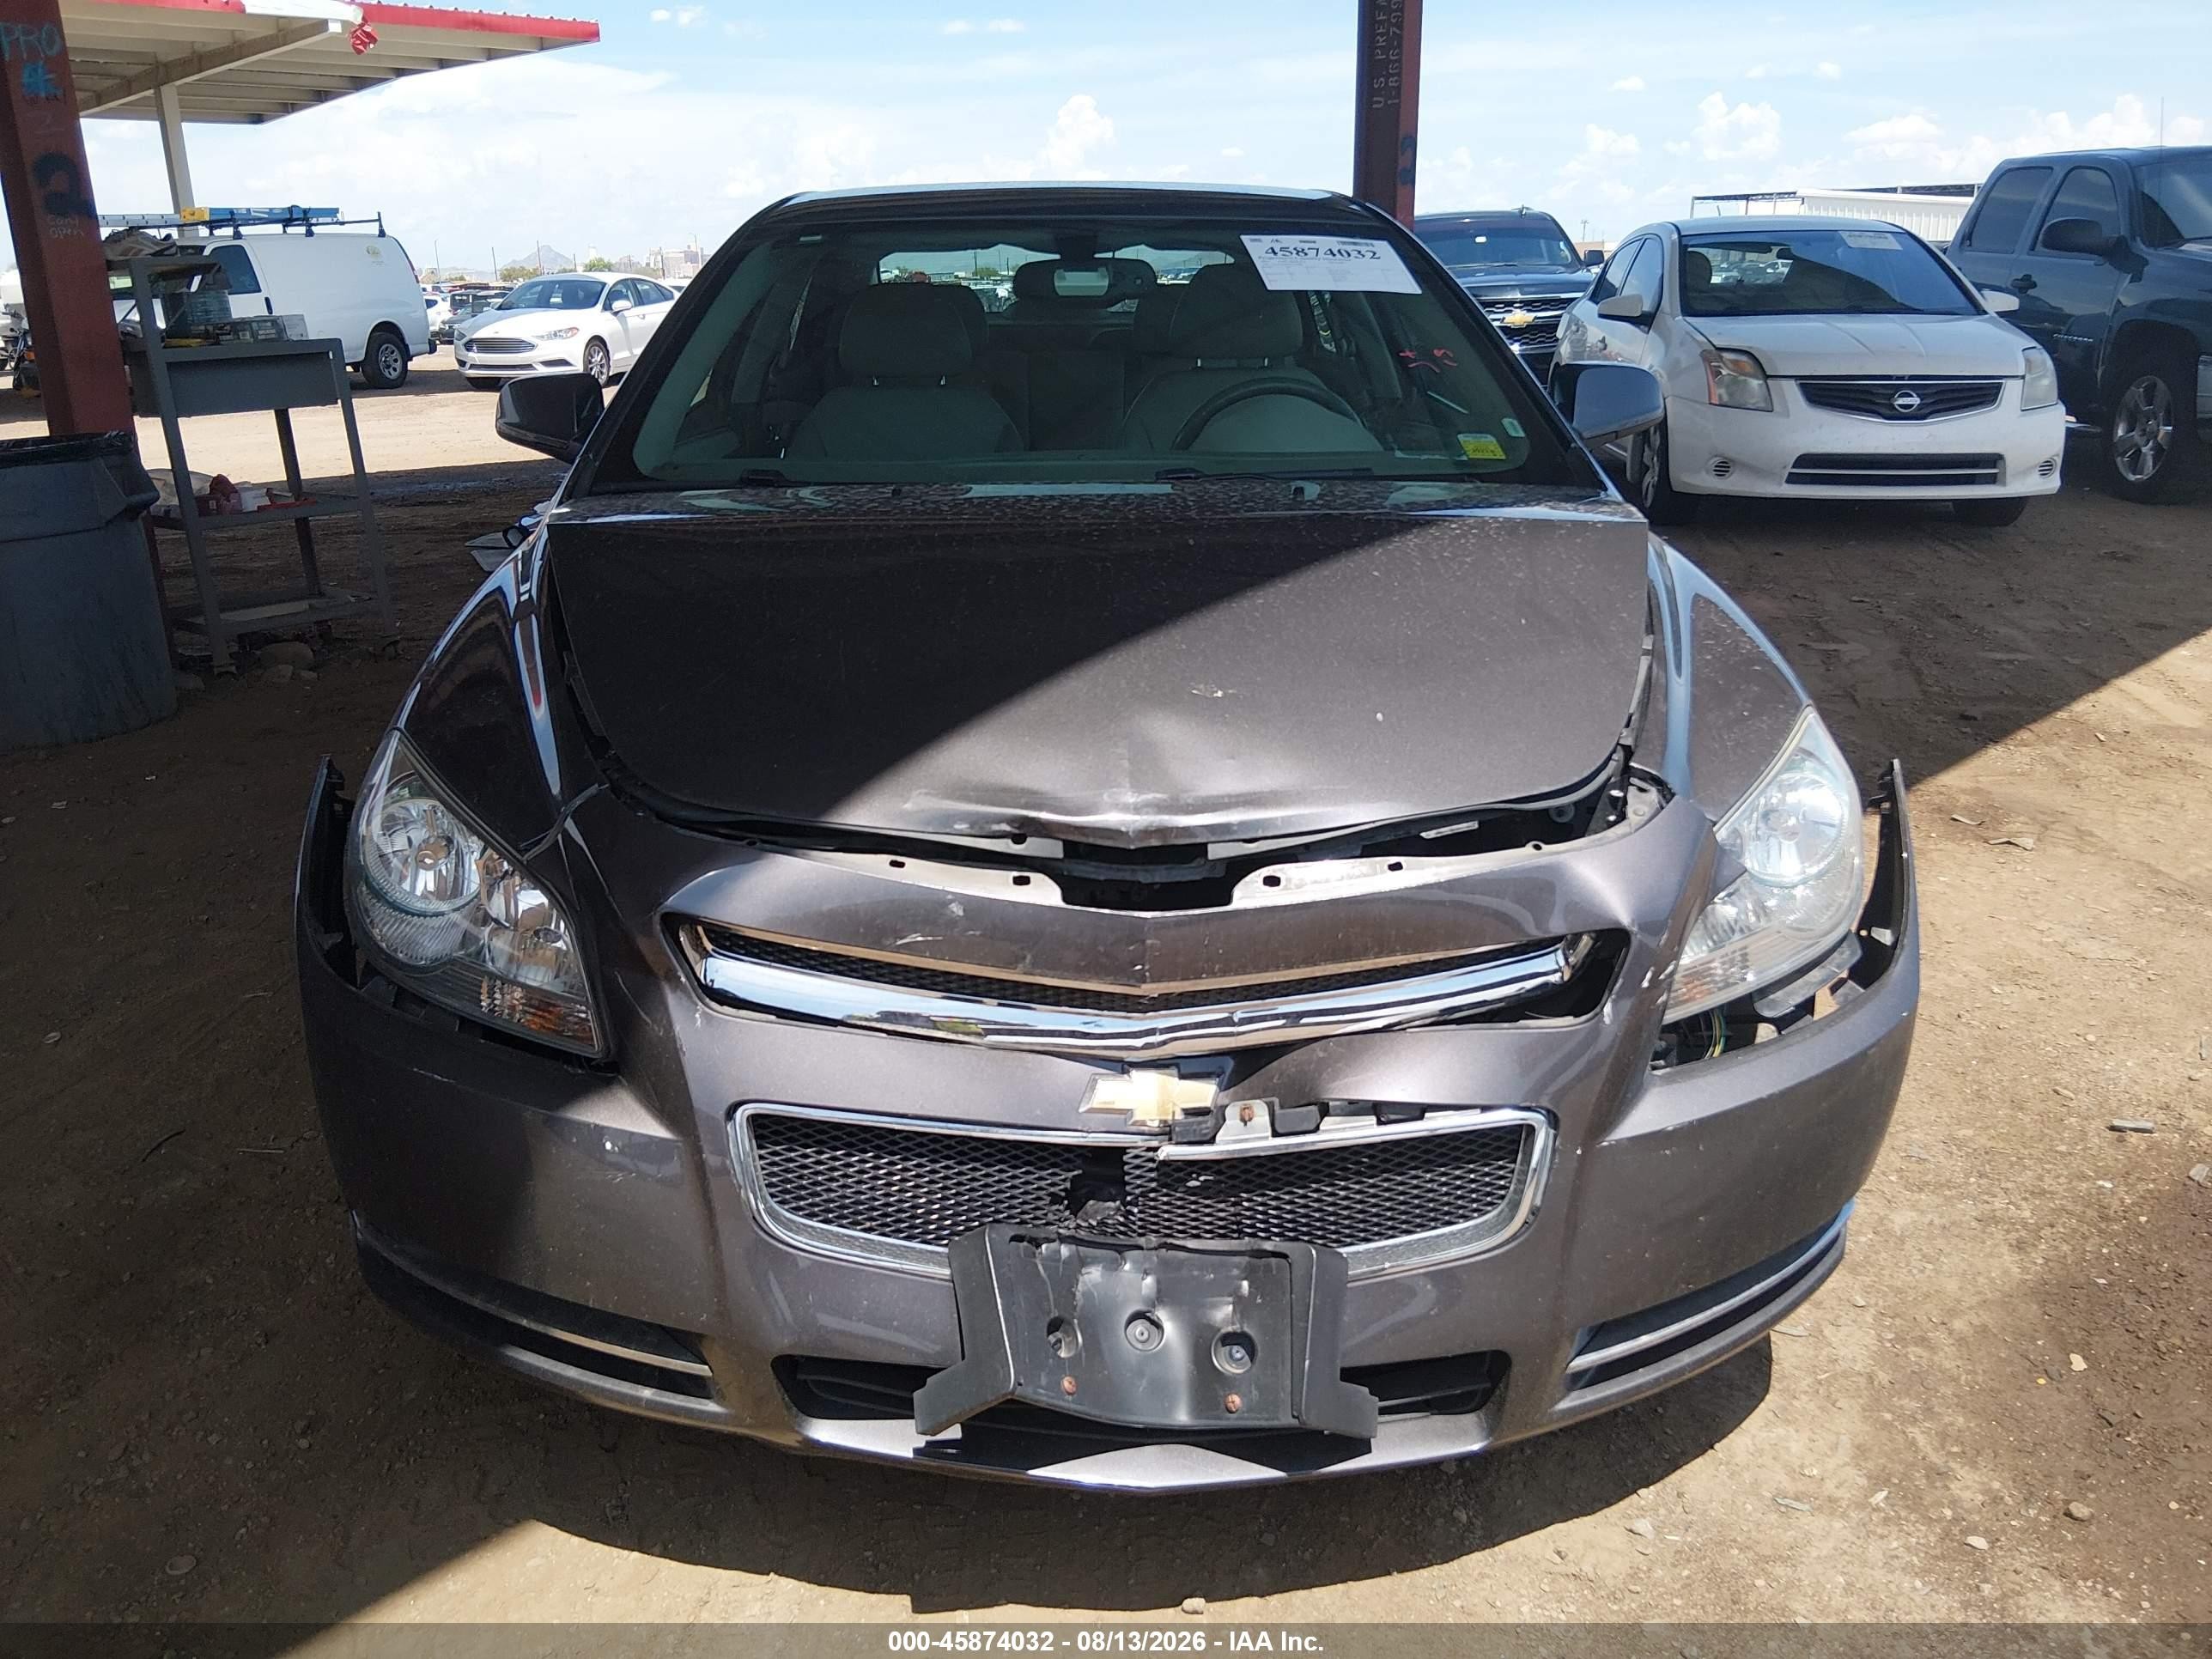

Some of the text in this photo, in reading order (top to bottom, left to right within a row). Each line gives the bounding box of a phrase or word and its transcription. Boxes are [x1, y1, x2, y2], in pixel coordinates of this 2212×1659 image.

[0, 21, 62, 62] PRO
[1372, 71, 1386, 108] U.S.
[1264, 246, 1382, 260] 45874032
